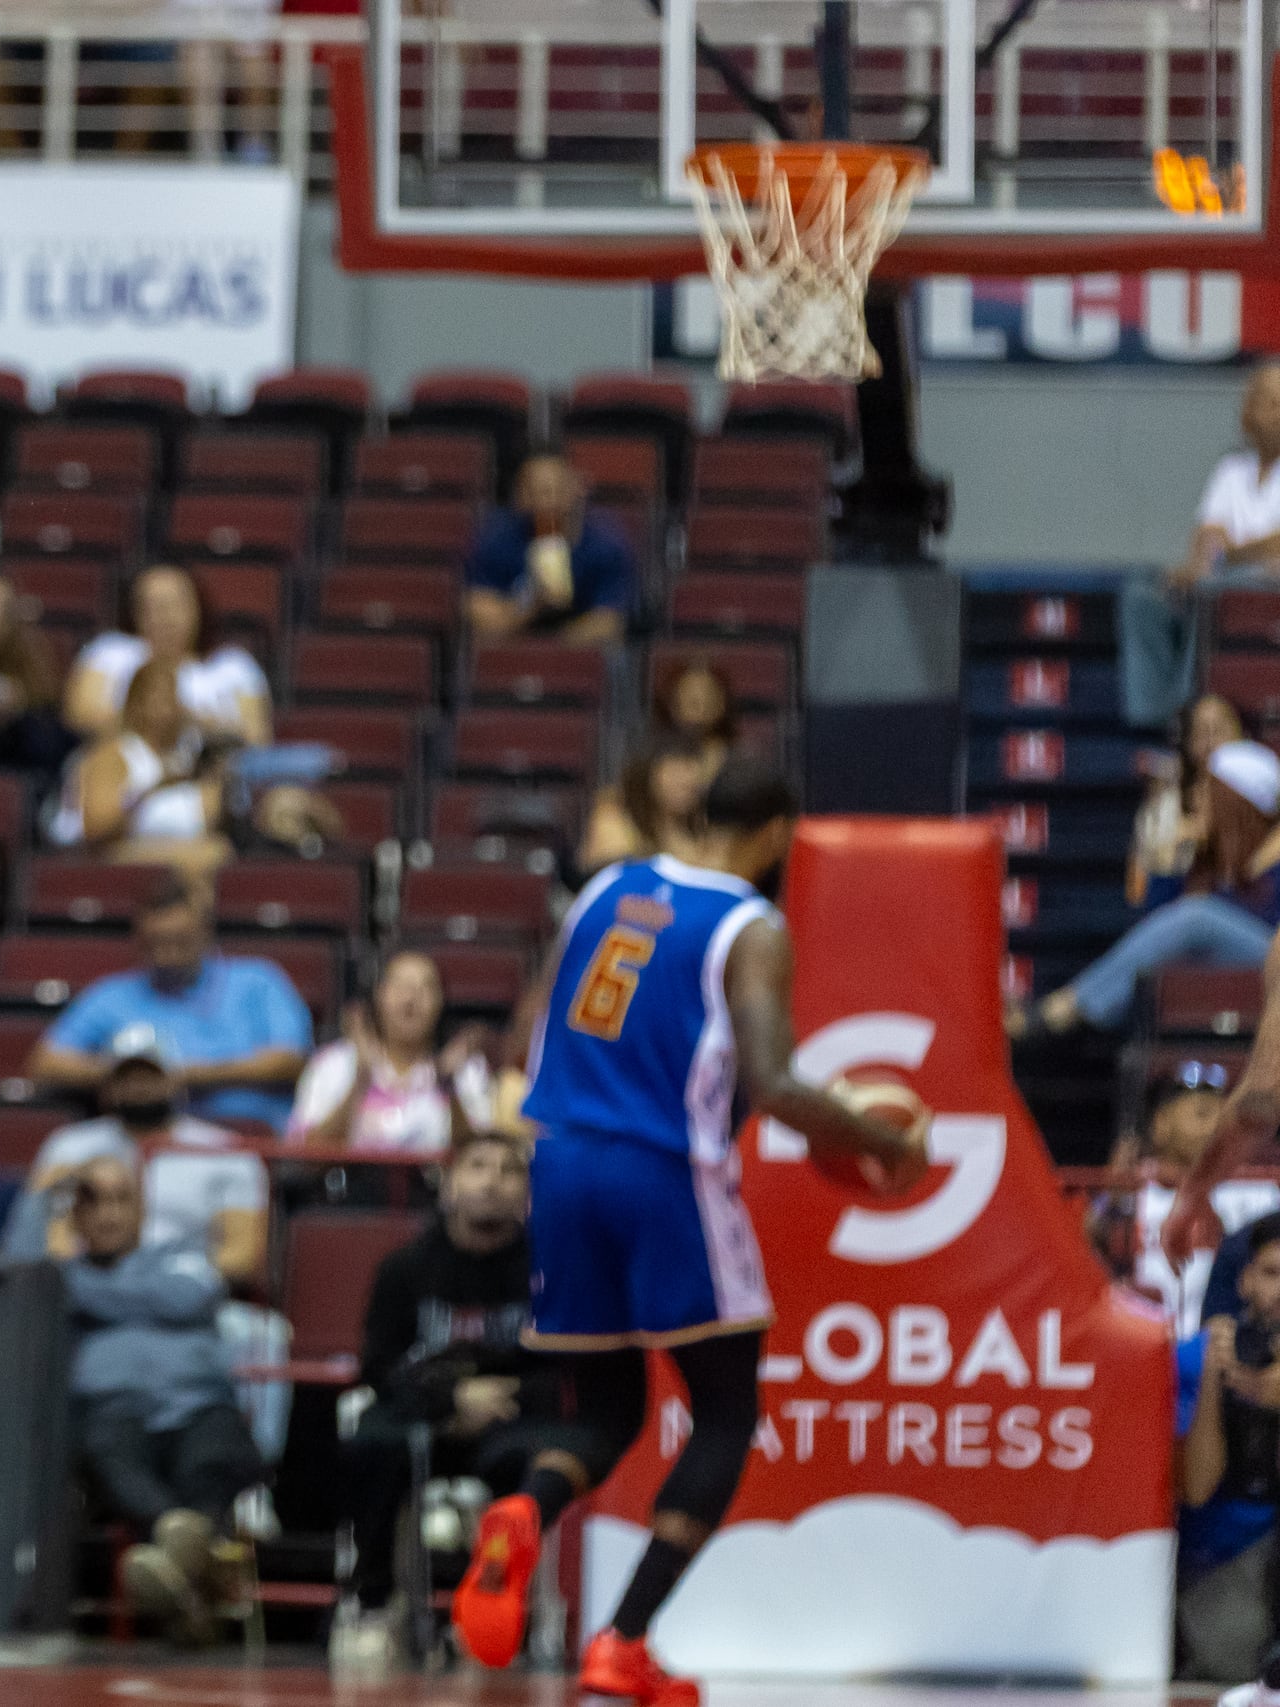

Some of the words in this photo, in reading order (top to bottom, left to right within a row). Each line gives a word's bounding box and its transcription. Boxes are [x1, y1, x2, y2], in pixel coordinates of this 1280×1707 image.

[27, 259, 266, 331] LUCAS
[569, 923, 658, 1042] 6
[757, 1302, 1095, 1388] OBAL
